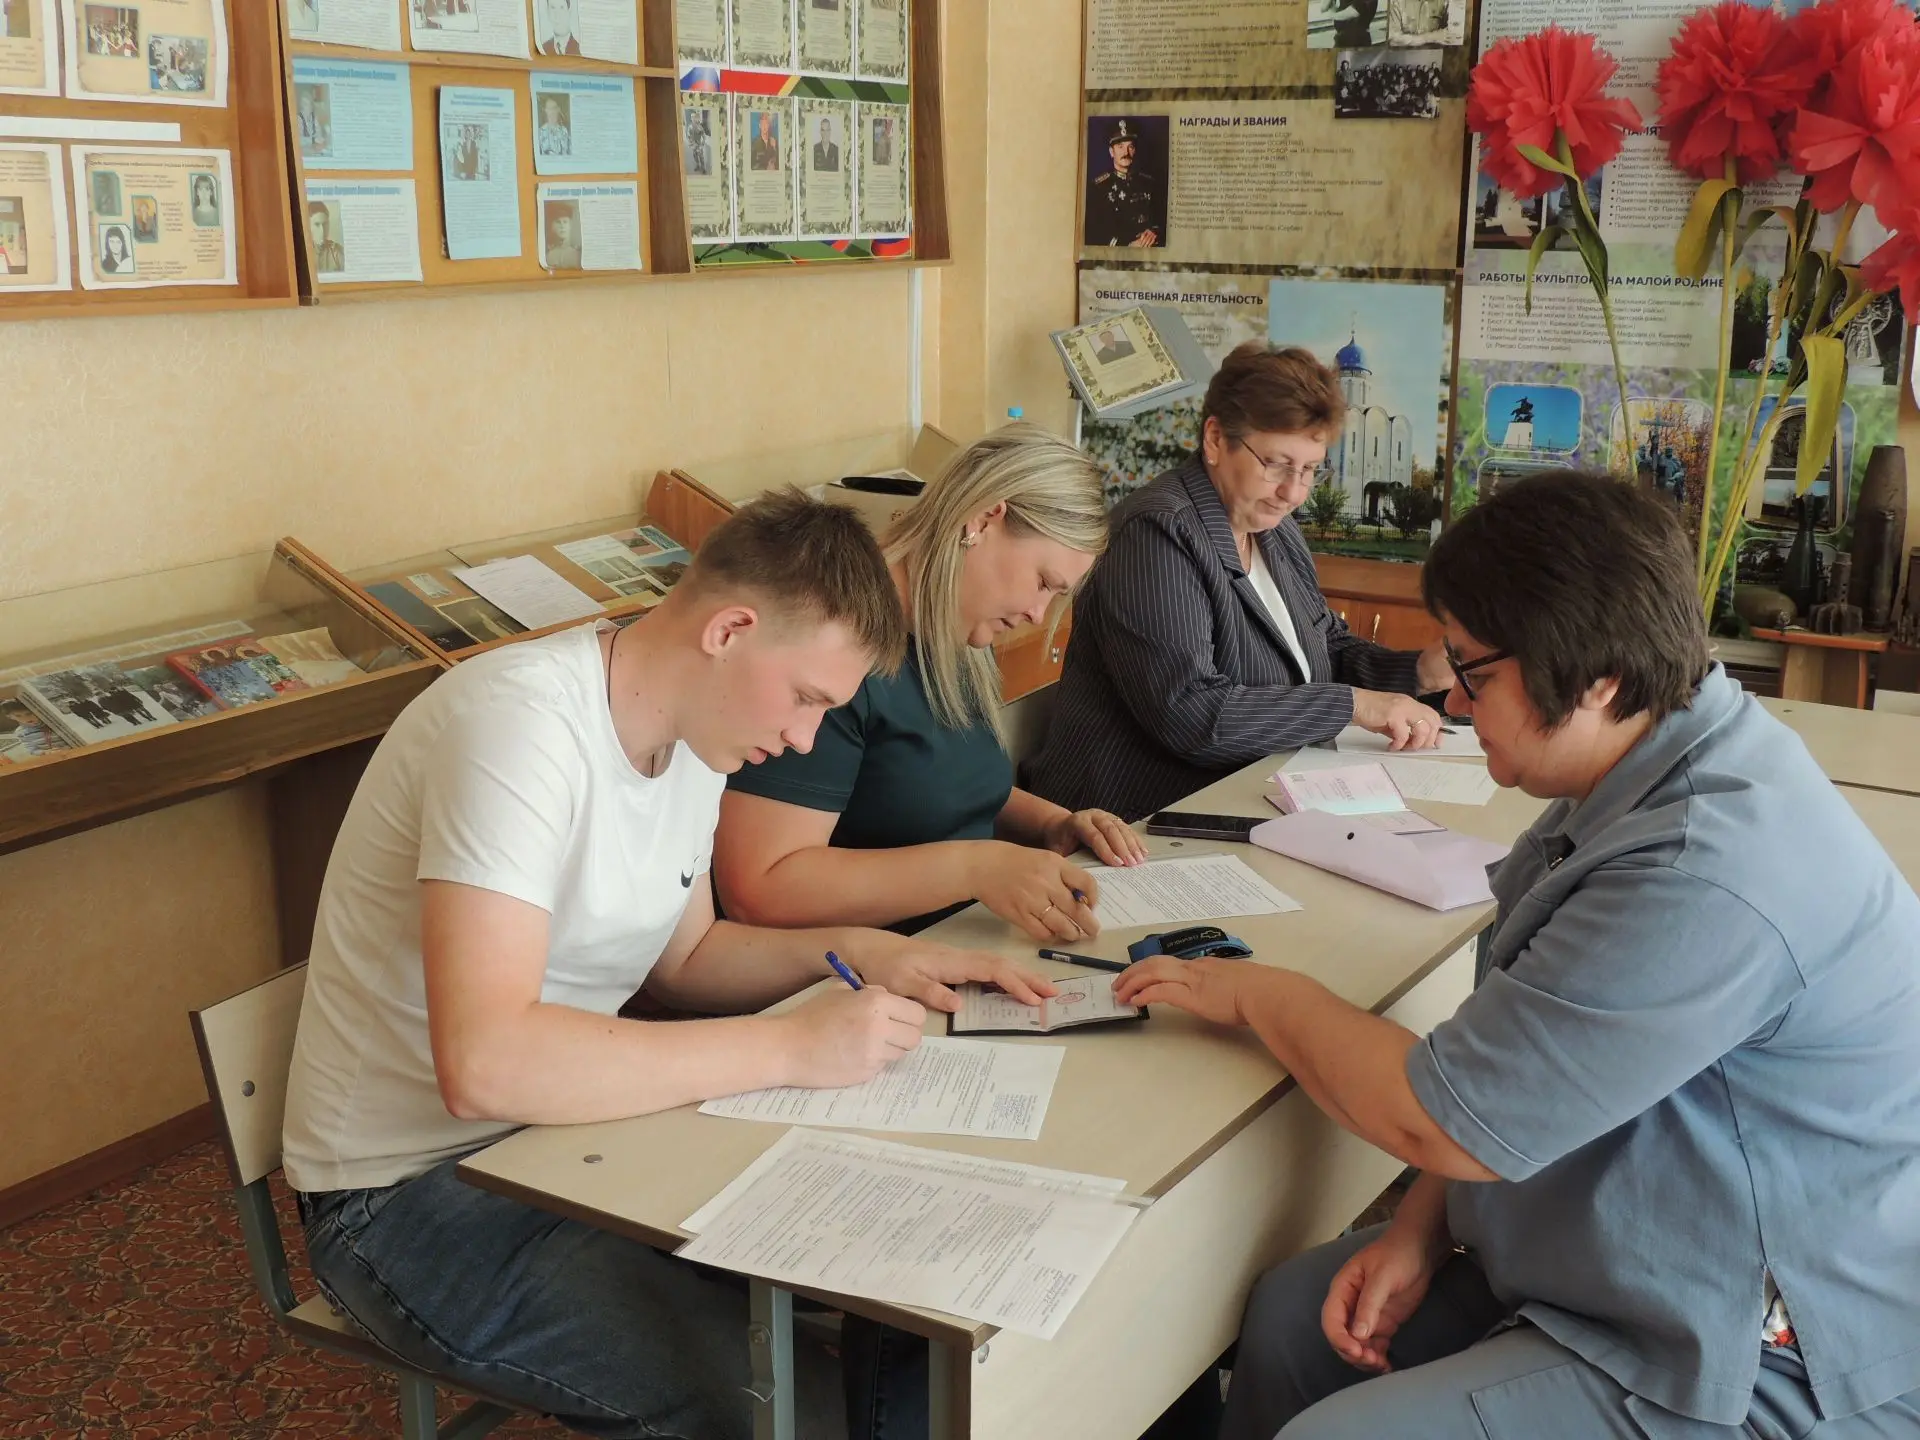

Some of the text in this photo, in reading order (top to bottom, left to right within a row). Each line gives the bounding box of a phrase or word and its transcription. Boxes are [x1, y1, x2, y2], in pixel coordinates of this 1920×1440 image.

[1179, 117, 1287, 127] НАГРАДЫ И ЗВАНИЯ
[1480, 273, 1725, 288] РАБОТЫ КУЛЬПТО НА МАЛОЙ РОДИНЕ
[1095, 290, 1264, 305] ОБЩЕСТВЕННАЯ ДЕЯТЕЛЬНОСТЬ
